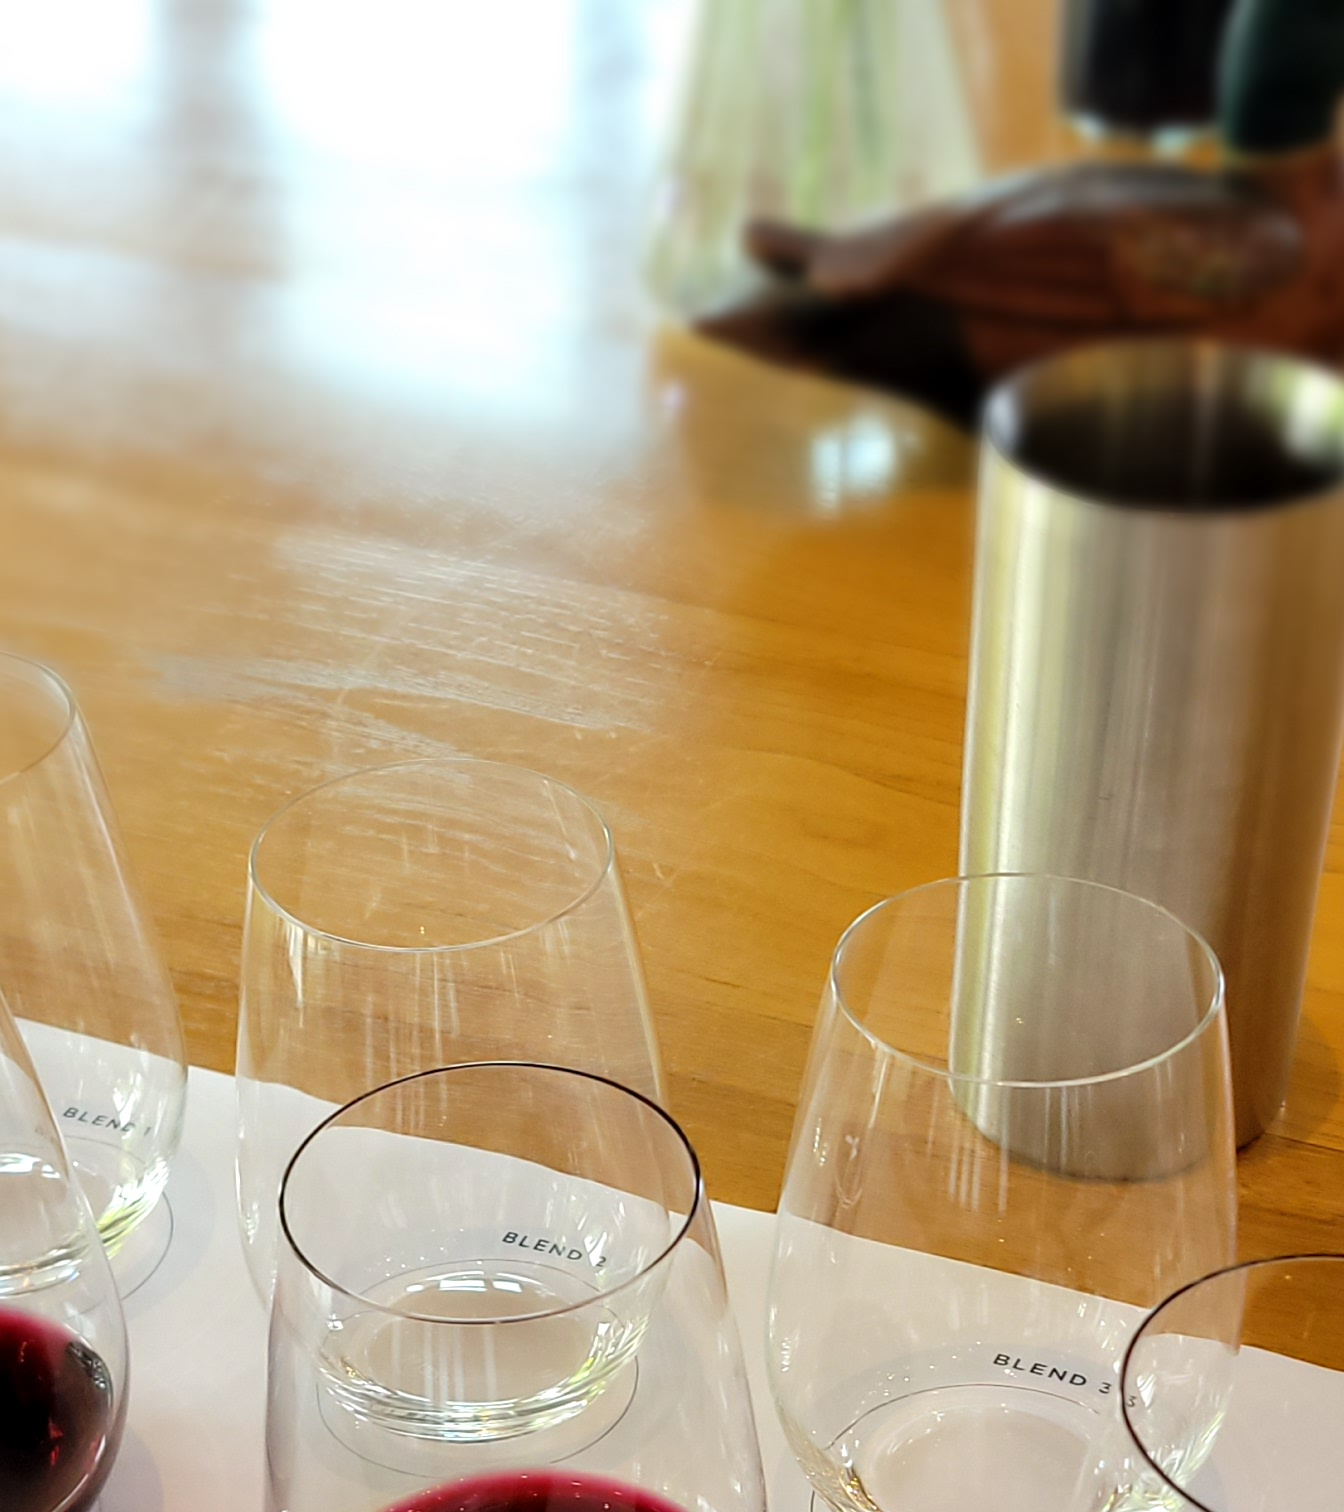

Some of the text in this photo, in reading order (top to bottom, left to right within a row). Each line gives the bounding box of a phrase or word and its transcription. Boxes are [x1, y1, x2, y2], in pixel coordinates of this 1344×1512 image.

[62, 1106, 152, 1137] BLEND 1
[502, 1231, 607, 1268] BLEND 2
[992, 1353, 1112, 1395] BLEND 3
